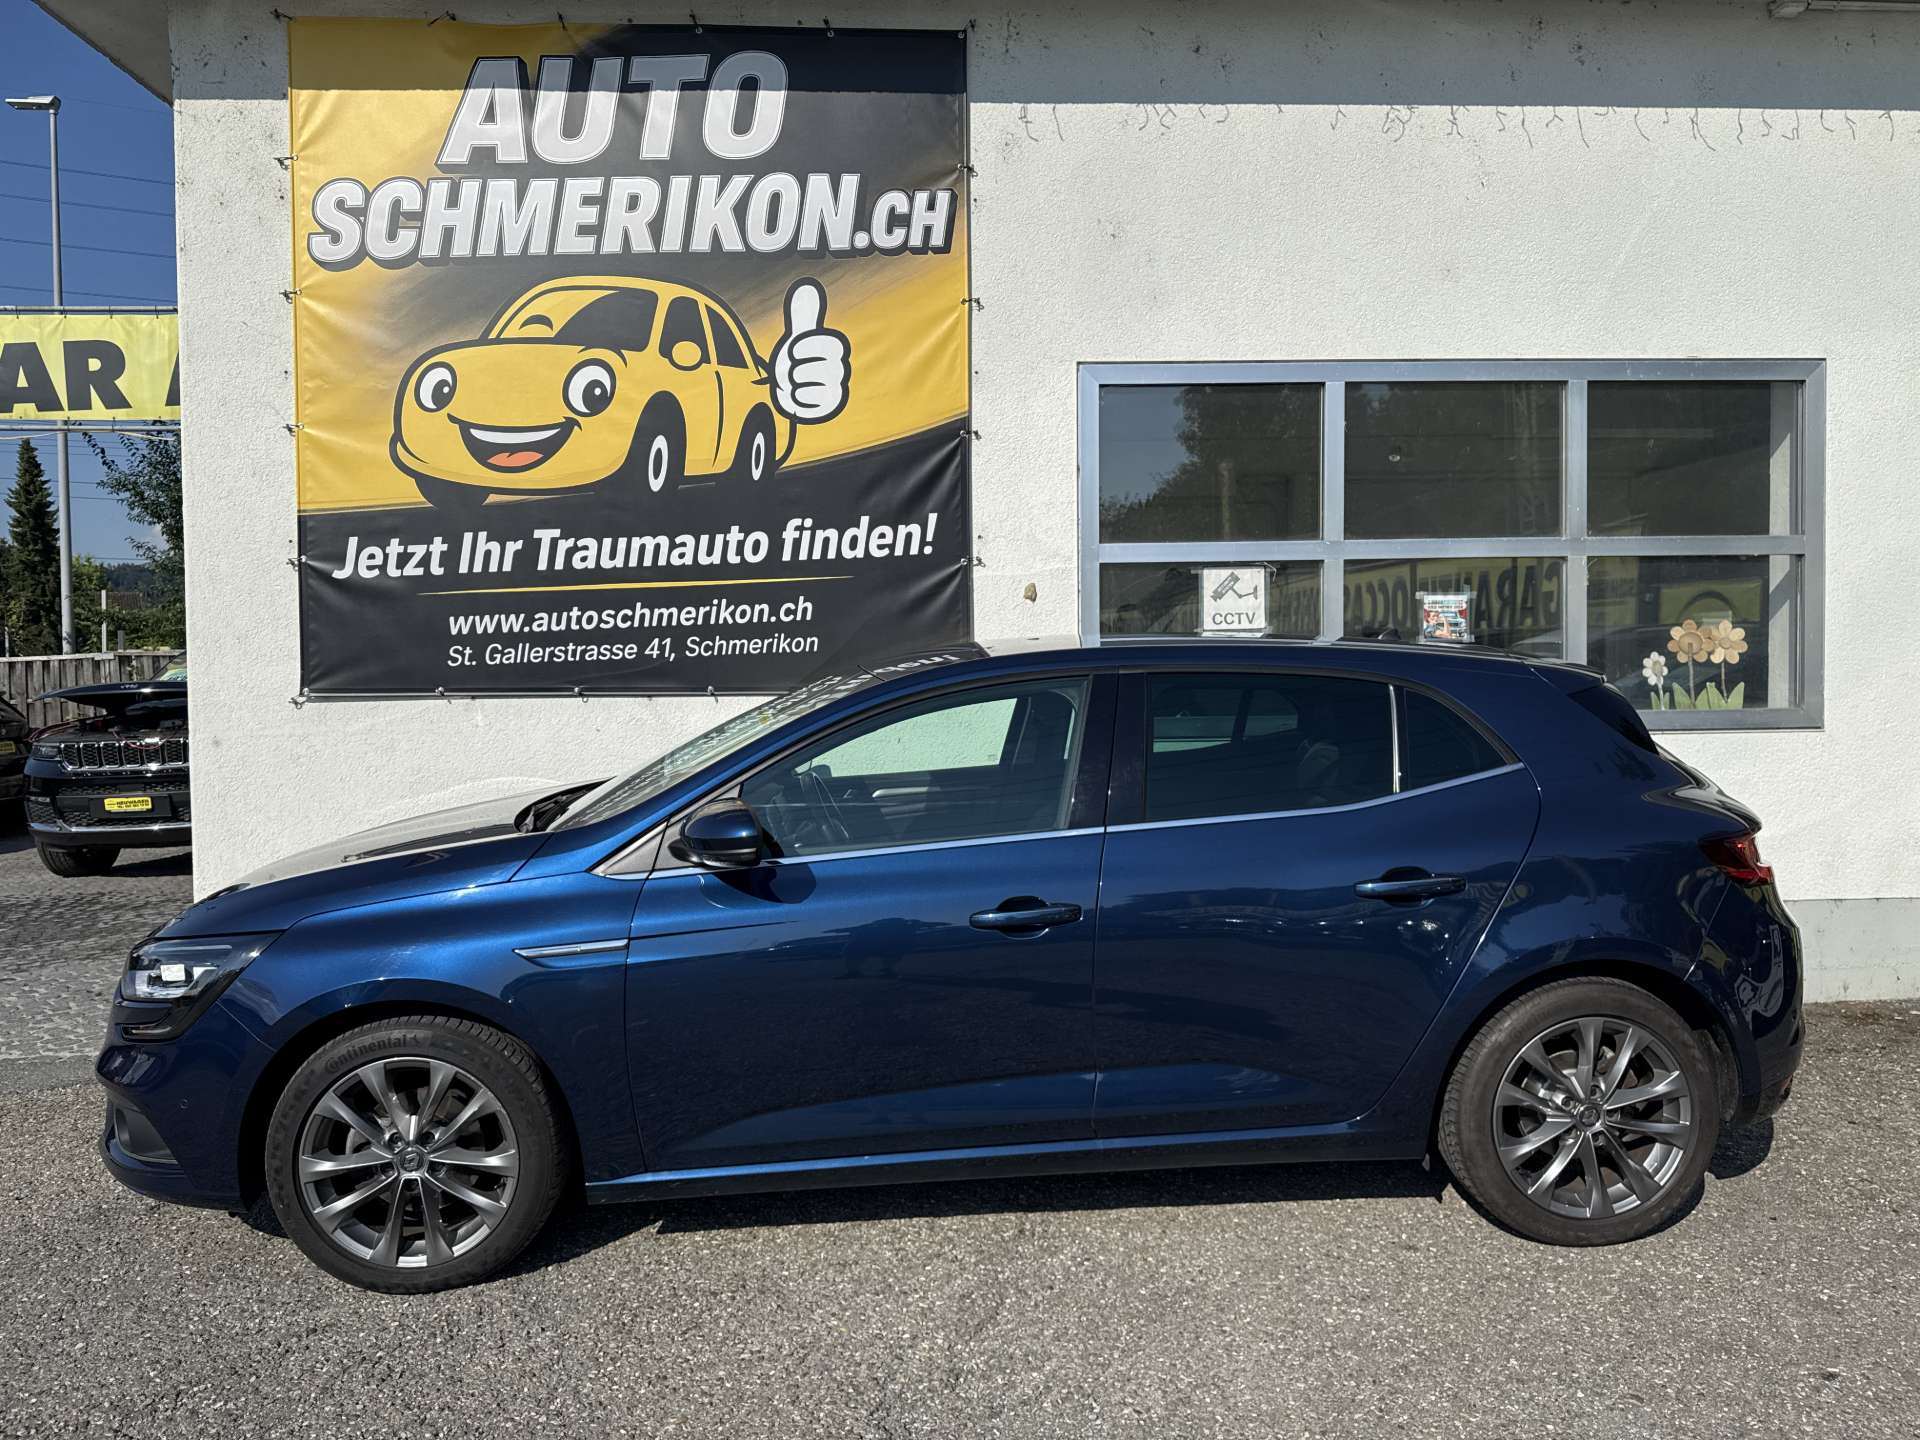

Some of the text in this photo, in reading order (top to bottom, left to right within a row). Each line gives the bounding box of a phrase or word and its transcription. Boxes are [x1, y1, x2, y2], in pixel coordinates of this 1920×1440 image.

[437, 50, 789, 164] AUTO
[308, 170, 952, 263] SCHMERIKON.CH
[332, 512, 938, 580] Jetzt Ihr Traumauto finden!
[449, 595, 813, 636] www.autoschmerikon.ch
[1212, 611, 1256, 626] CCTV
[447, 634, 819, 667] St. Gallerstrasse 41, Schmerikon
[326, 1034, 408, 1073] Continental
